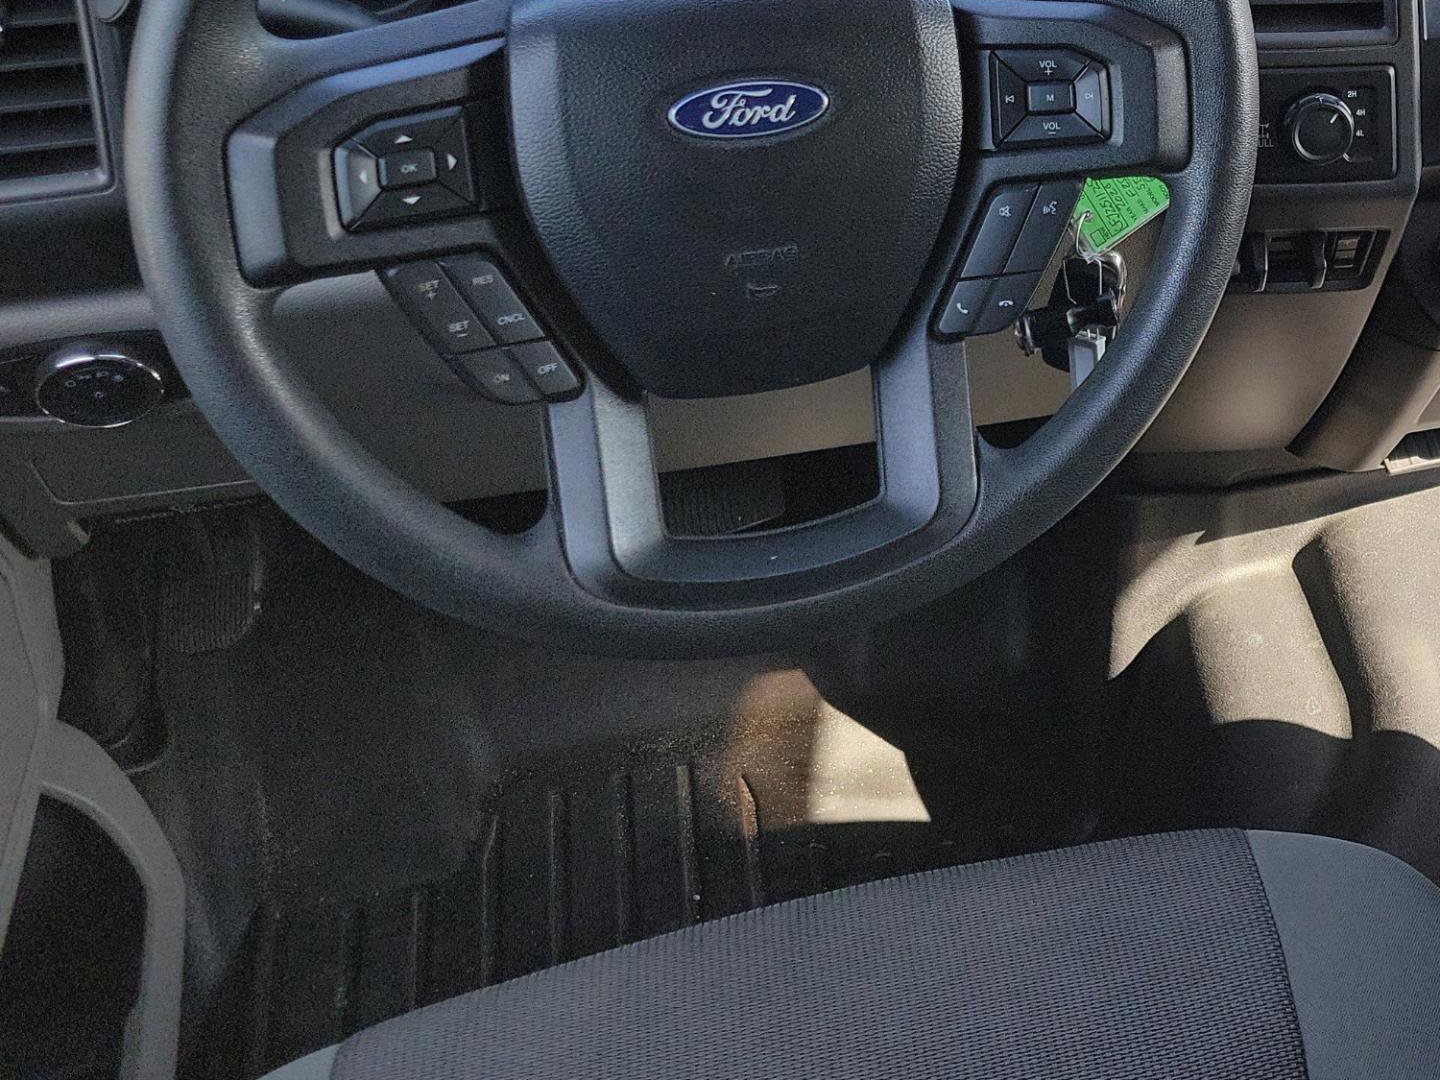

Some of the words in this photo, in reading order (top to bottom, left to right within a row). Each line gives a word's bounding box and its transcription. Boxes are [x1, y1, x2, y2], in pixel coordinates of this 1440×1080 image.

[1039, 60, 1057, 69] VOL
[702, 88, 797, 130] Ford
[1356, 109, 1366, 117] 4H
[1043, 122, 1061, 131] VOL
